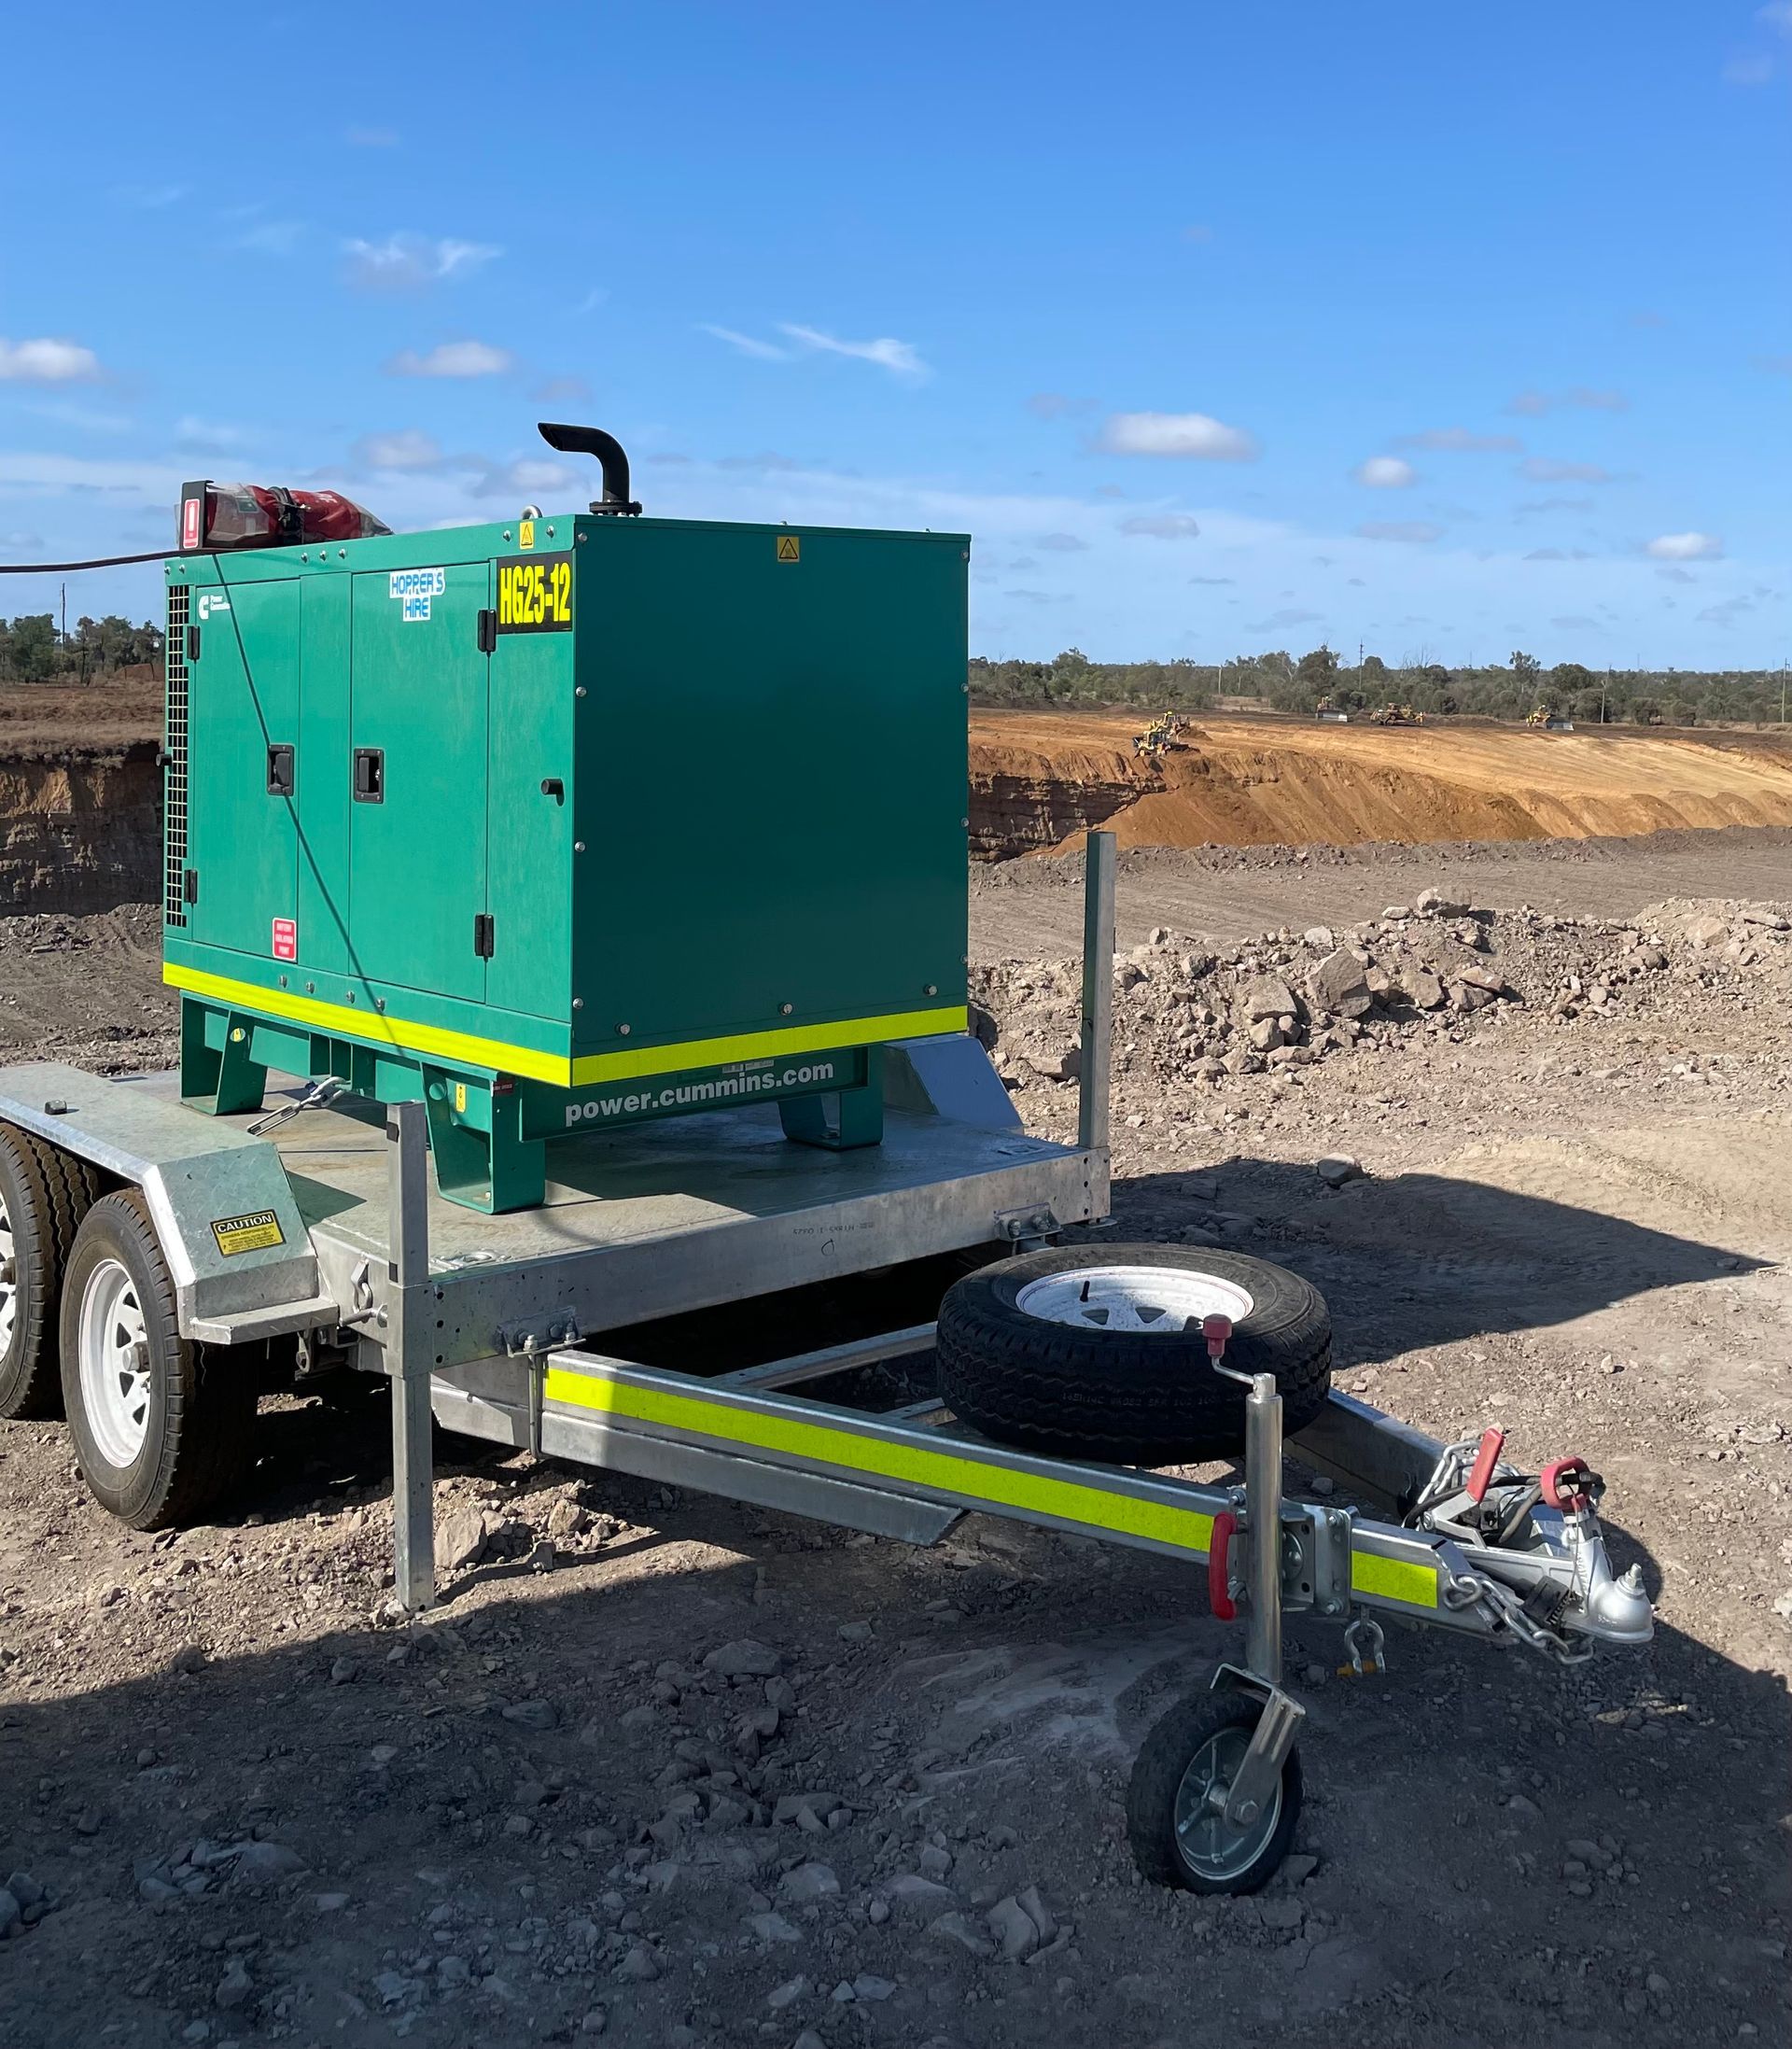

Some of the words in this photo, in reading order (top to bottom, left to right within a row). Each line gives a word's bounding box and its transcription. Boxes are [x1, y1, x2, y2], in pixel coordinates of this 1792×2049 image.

[391, 571, 444, 596] HOPPER'S
[499, 561, 571, 625] HG25-12
[404, 596, 429, 618] HIRE
[565, 1060, 834, 1127] power.cummins.com
[217, 1214, 273, 1233] CAUTION
